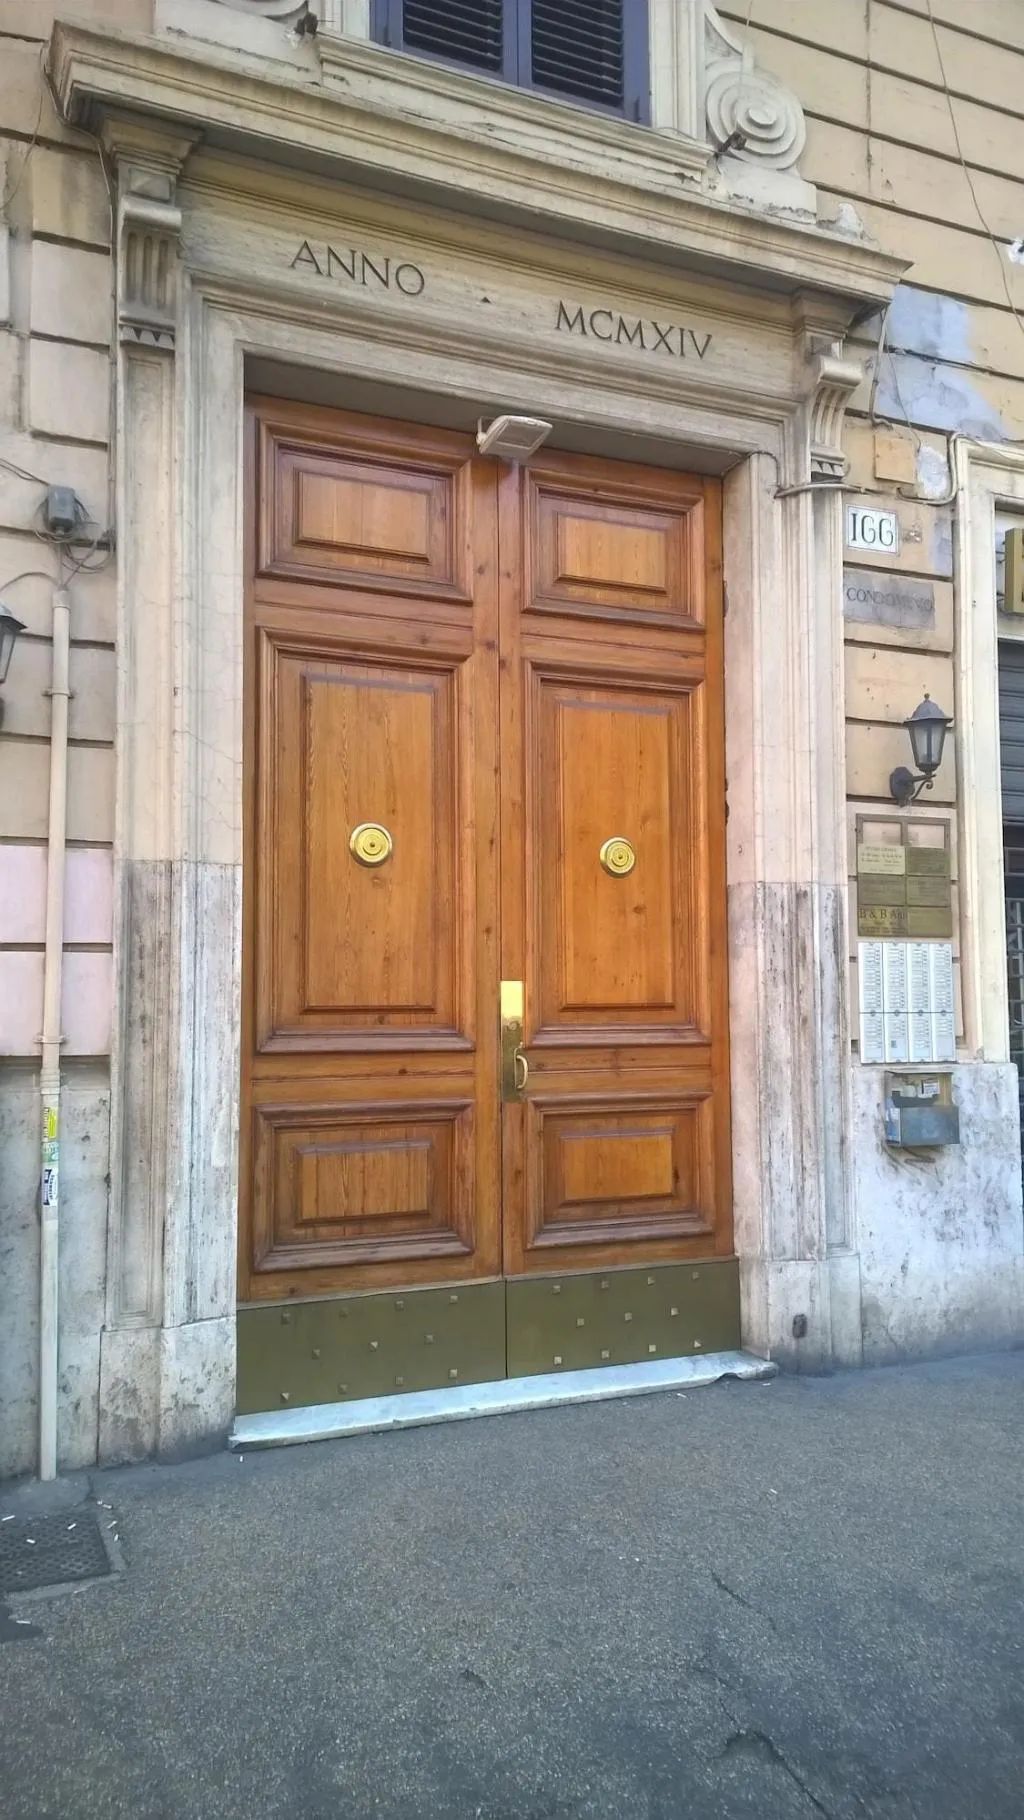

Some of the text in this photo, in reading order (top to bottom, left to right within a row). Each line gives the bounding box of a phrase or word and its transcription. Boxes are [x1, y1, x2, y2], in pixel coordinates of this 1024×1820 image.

[288, 240, 713, 360] ANNO MCMXIV
[851, 512, 894, 547] 166
[869, 908, 878, 920] &
[880, 908, 888, 920] B
